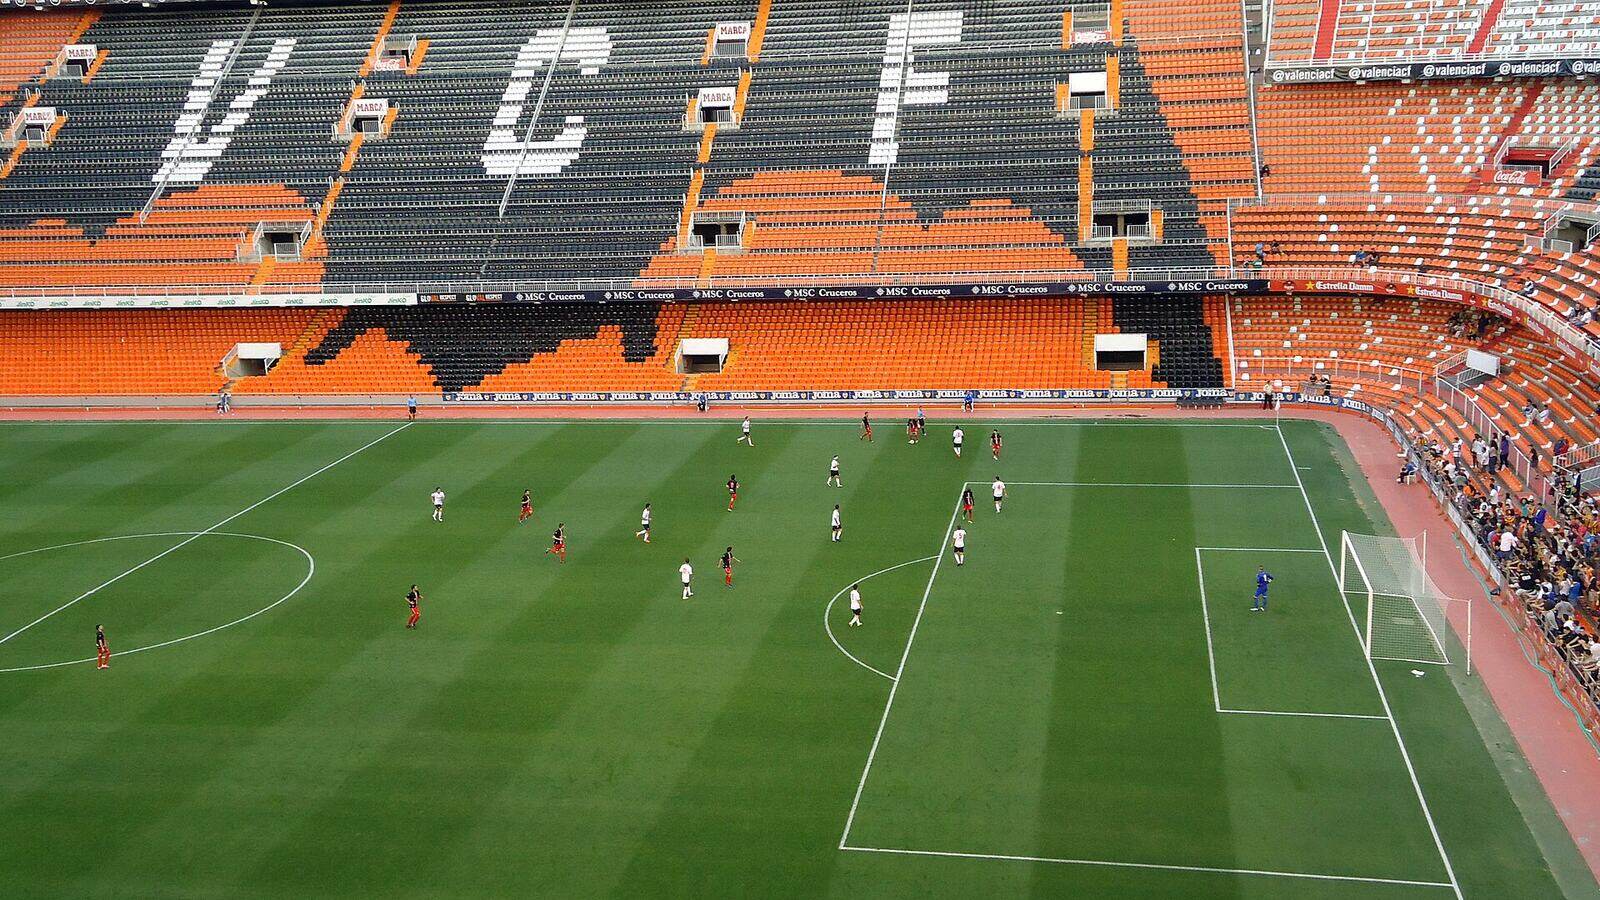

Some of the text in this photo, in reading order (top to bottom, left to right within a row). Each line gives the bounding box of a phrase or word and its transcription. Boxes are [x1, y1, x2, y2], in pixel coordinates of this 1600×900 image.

[720, 26, 747, 35] MARCA
[68, 49, 95, 58] MARCA
[1348, 65, 1412, 80] @valenciacf
[1423, 63, 1487, 77] @valenciacf
[1499, 61, 1560, 76] @valenciacf
[1272, 67, 1335, 82] @valenciacf
[480, 28, 613, 175] C
[868, 11, 964, 164] F
[703, 92, 732, 102] MARCA
[356, 103, 384, 112] MARCA
[25, 112, 53, 121] MARCA
[981, 285, 1049, 294] MSC Cruceros
[1077, 283, 1146, 292] MSC Cruceros
[1178, 281, 1249, 291] MSC Cruceros
[1315, 281, 1374, 292] Estrella Damm
[613, 291, 675, 299] MSC Cruceros
[701, 290, 765, 298] MSC Cruceros
[793, 288, 858, 297] MSC Cruceros
[885, 287, 951, 296] MSC Cruceros
[524, 292, 586, 301] MSC Cruceros
